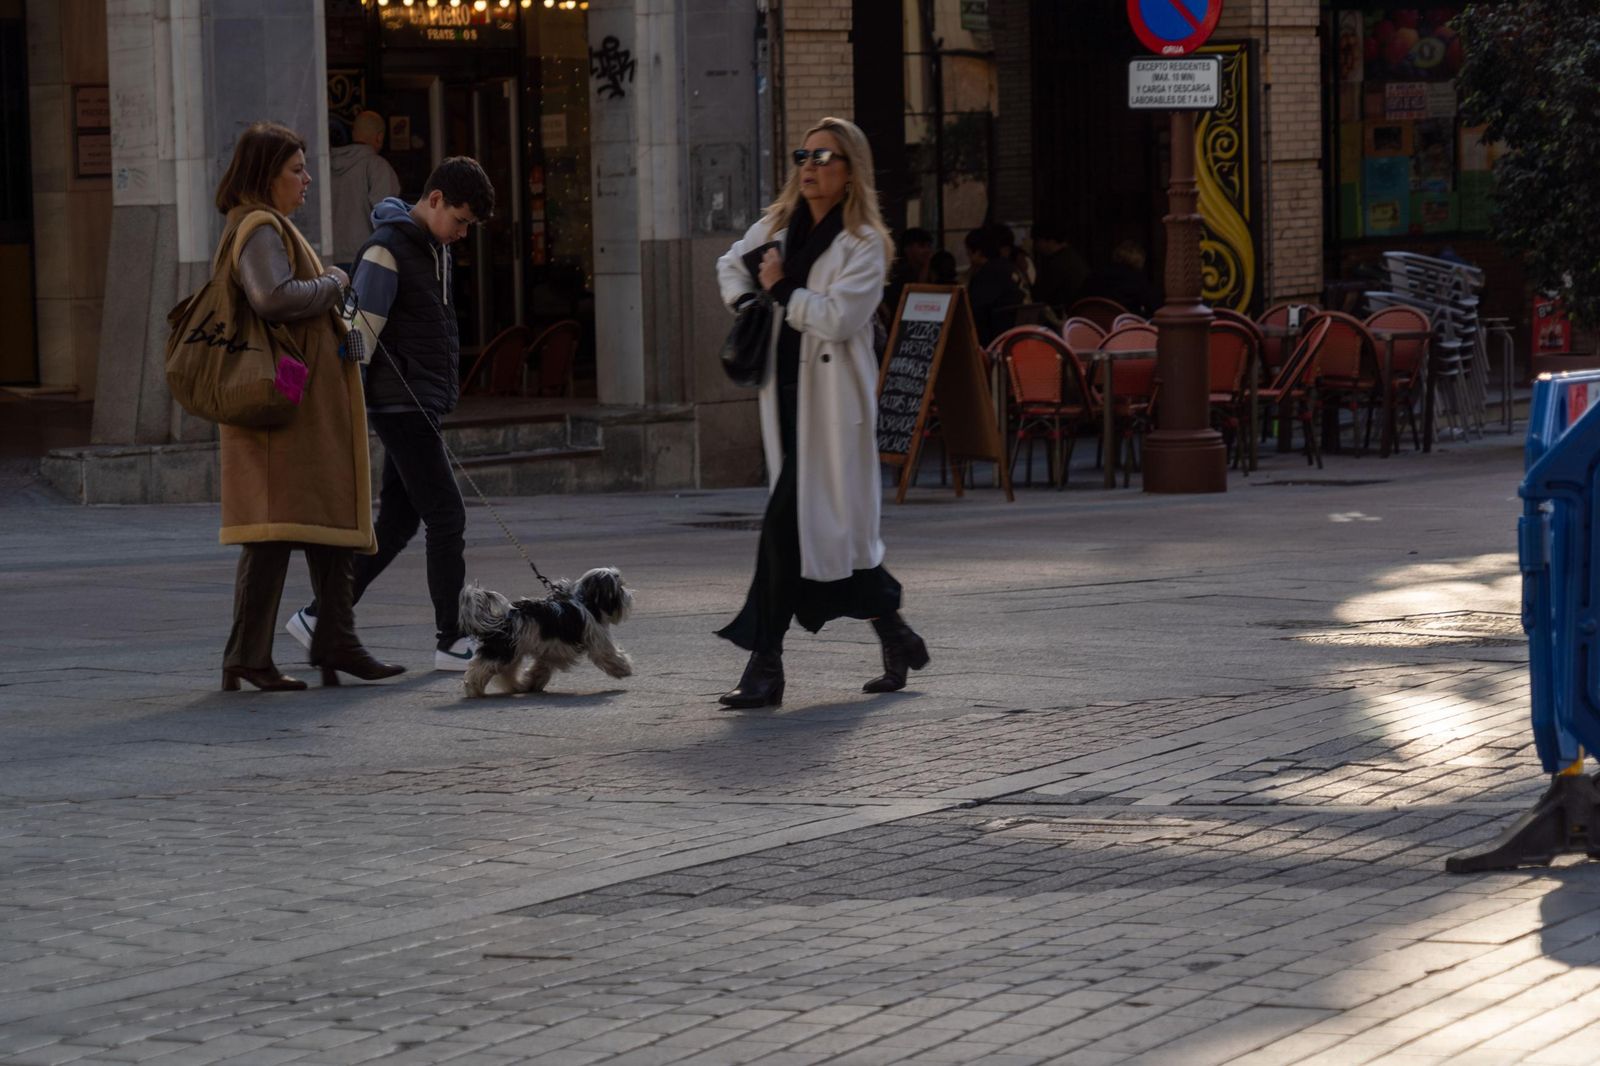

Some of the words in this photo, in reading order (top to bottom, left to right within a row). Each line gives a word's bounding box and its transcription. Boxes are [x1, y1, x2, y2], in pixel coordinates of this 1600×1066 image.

[1162, 45, 1185, 54] GRUA
[1136, 62, 1168, 71] EXCEPTO
[1169, 62, 1211, 71] RESIDENTES
[1172, 73, 1180, 81] 10
[1181, 73, 1196, 82] MIN)
[1136, 85, 1141, 93] Y
[1142, 84, 1166, 93] CARGA
[1168, 84, 1173, 92] Y
[1174, 84, 1211, 93] DESCARGA
[1131, 95, 1175, 105] LABORABLES
[1177, 95, 1187, 104] DE
[1193, 95, 1198, 104] A
